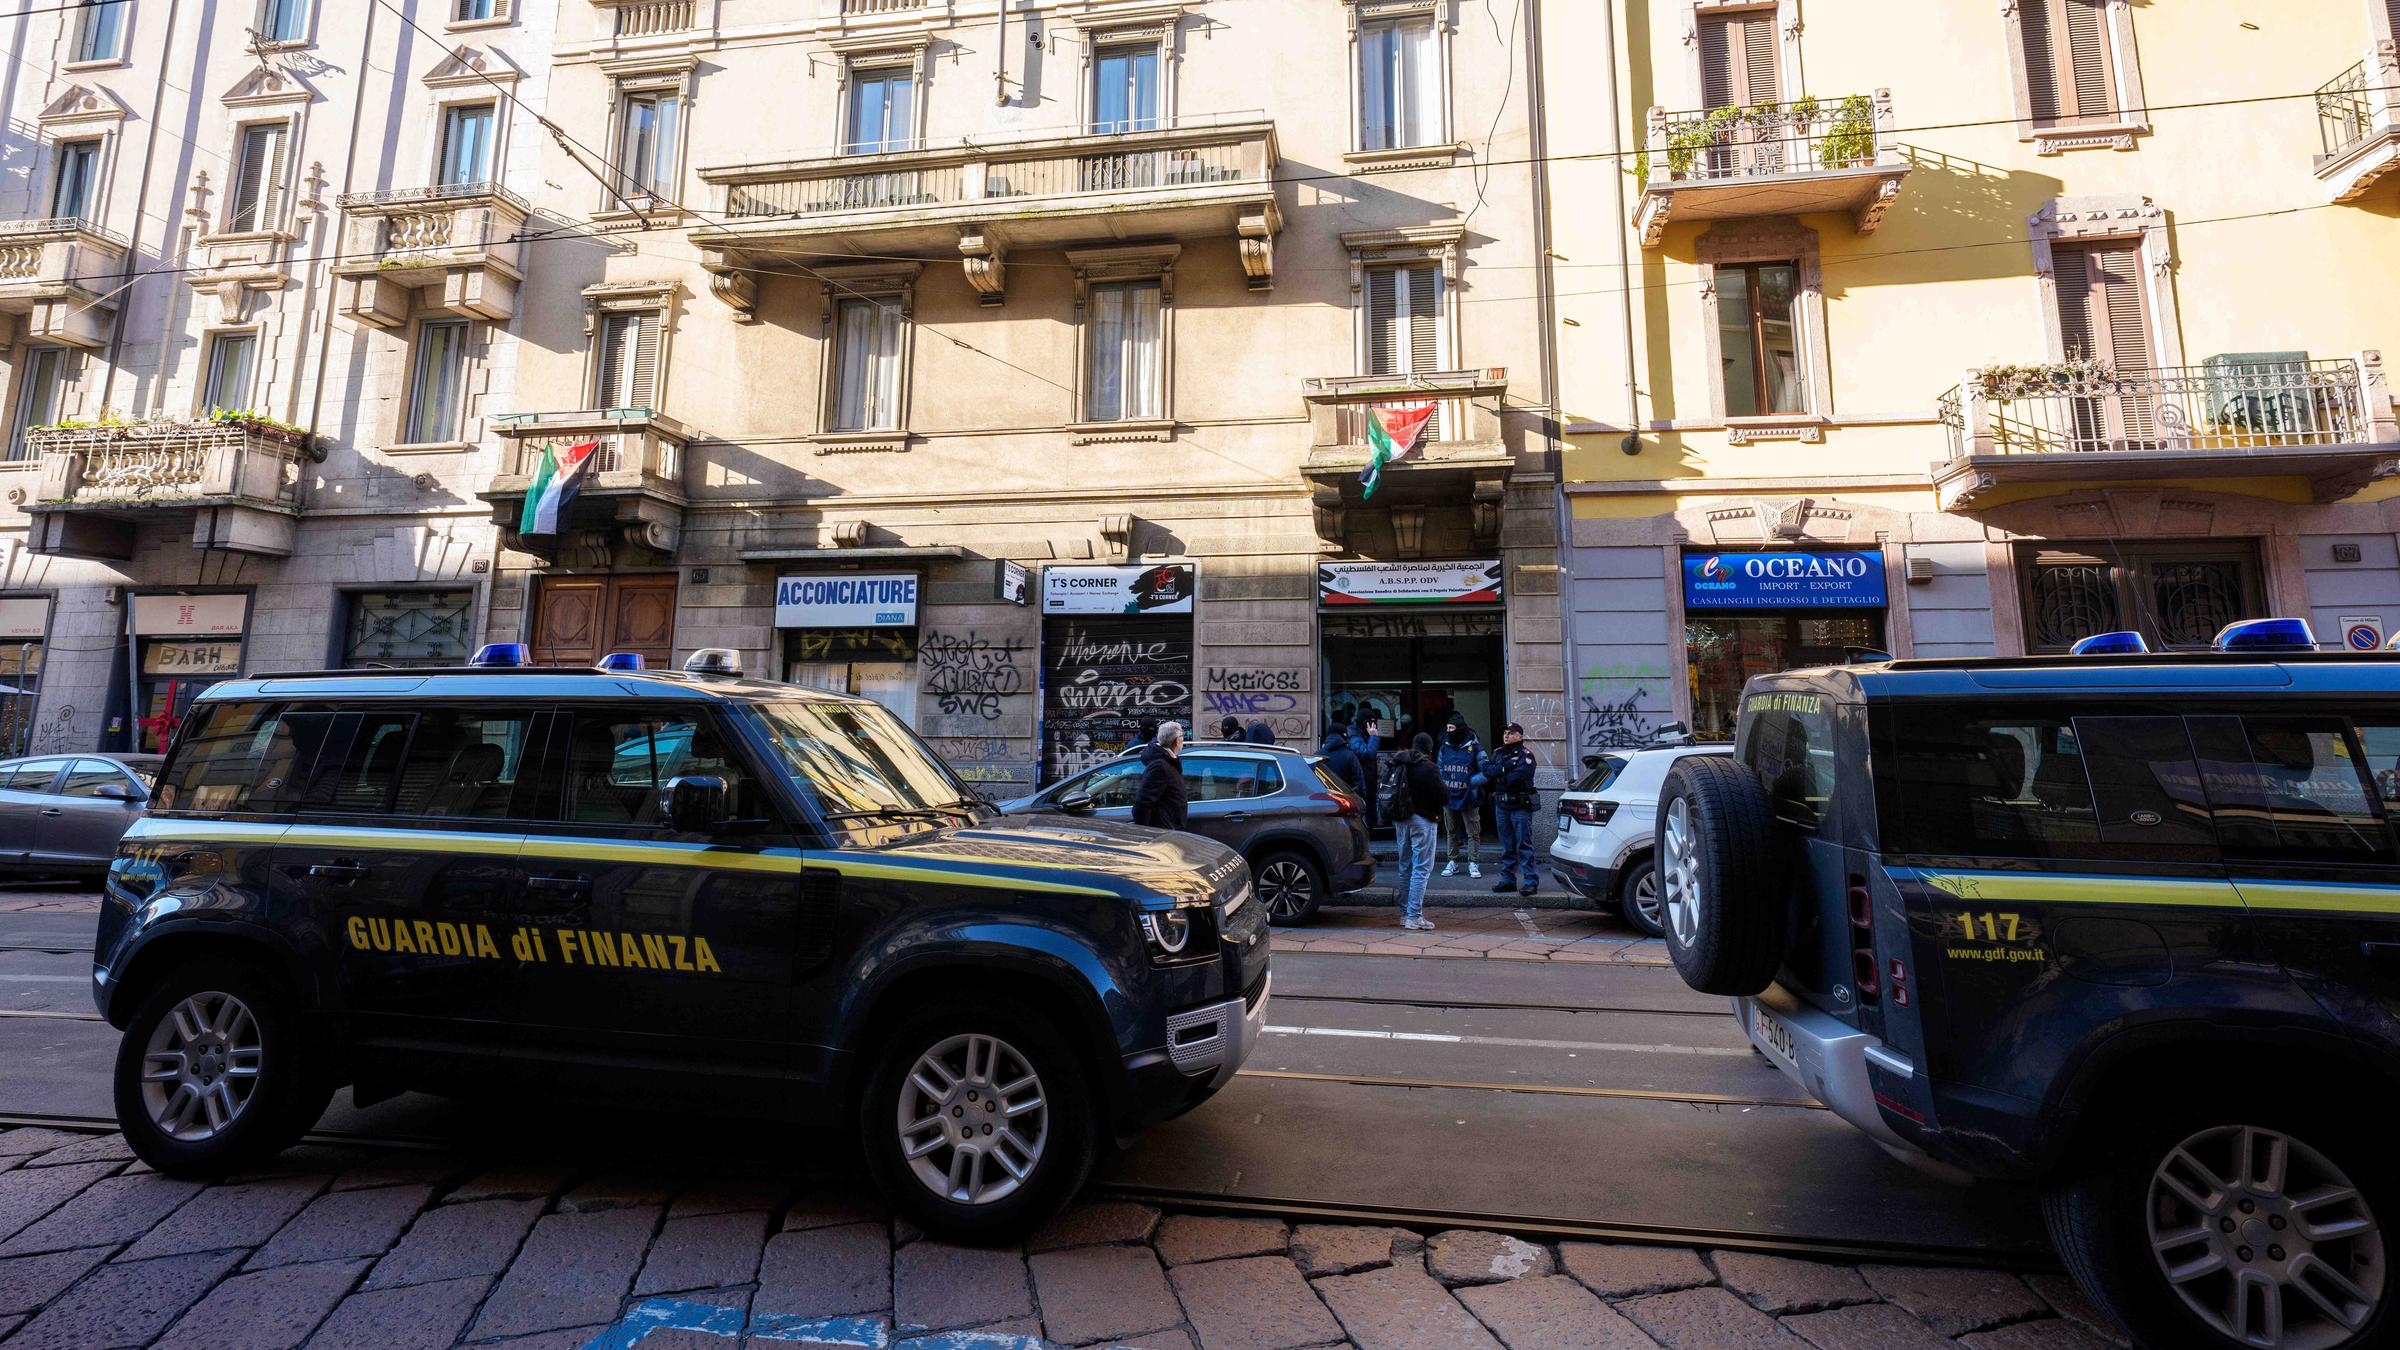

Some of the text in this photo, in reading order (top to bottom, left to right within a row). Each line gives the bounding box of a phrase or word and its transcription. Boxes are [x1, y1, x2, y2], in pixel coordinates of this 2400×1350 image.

[1334, 562, 1485, 575] الجمعية الخيرية لمناصرة الشعب الفلسطيني
[1745, 557, 1867, 578] OCEANO
[1050, 578, 1118, 588] T'S CORNER
[1379, 576, 1439, 585] A.B.S.P.P. ODV
[1694, 582, 1737, 590] OCEANO
[1759, 582, 1800, 590] IMPORT
[1810, 581, 1853, 590] EXPORT
[777, 579, 916, 606] ACCONCIATURE
[1692, 596, 1880, 605] CASALINGHI INGROSSO E DETTAGLIO
[876, 614, 905, 623] DIANA
[1747, 694, 1821, 715] GUARDIA di FINANZA
[133, 848, 165, 867] 117
[1957, 912, 2020, 941] 117
[347, 916, 722, 973] GUARDIA di FINANZA
[1947, 948, 2045, 962] www.gdf.gov.it
